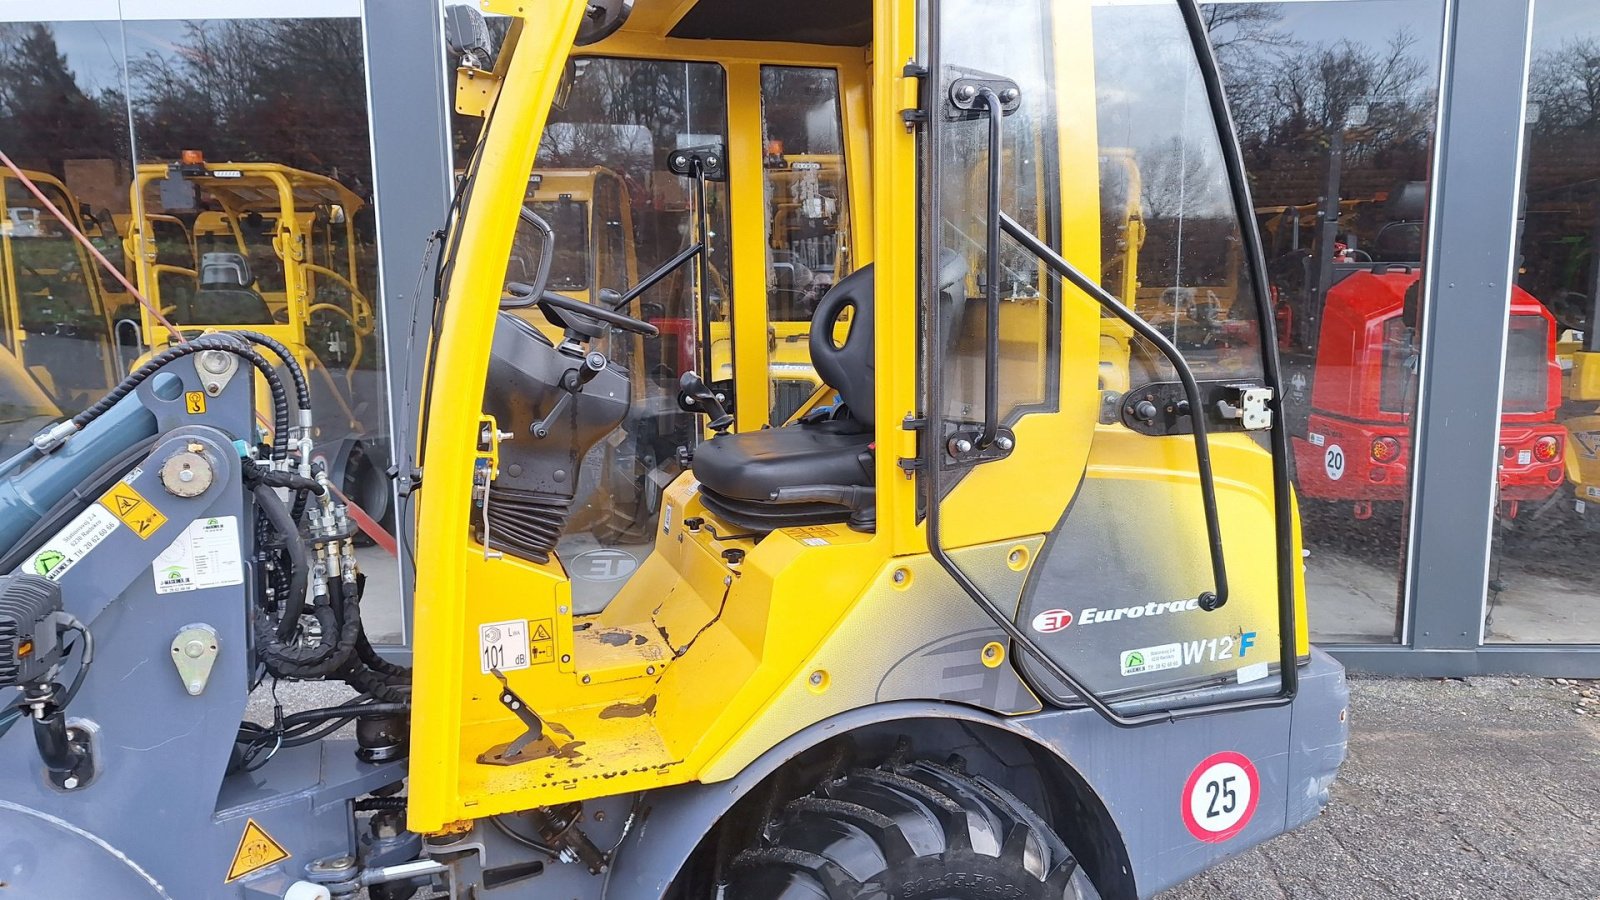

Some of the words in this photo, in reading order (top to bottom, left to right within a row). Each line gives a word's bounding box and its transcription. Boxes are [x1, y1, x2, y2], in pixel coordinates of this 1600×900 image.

[1327, 450, 1343, 470] 20
[92, 534, 101, 543] 62
[99, 528, 108, 537] 60
[1036, 610, 1071, 631] ET
[1077, 598, 1200, 626] Eurotrac
[484, 644, 504, 669] 101
[515, 653, 525, 665] dB
[1182, 636, 1233, 665] W12
[1206, 776, 1236, 819] 25
